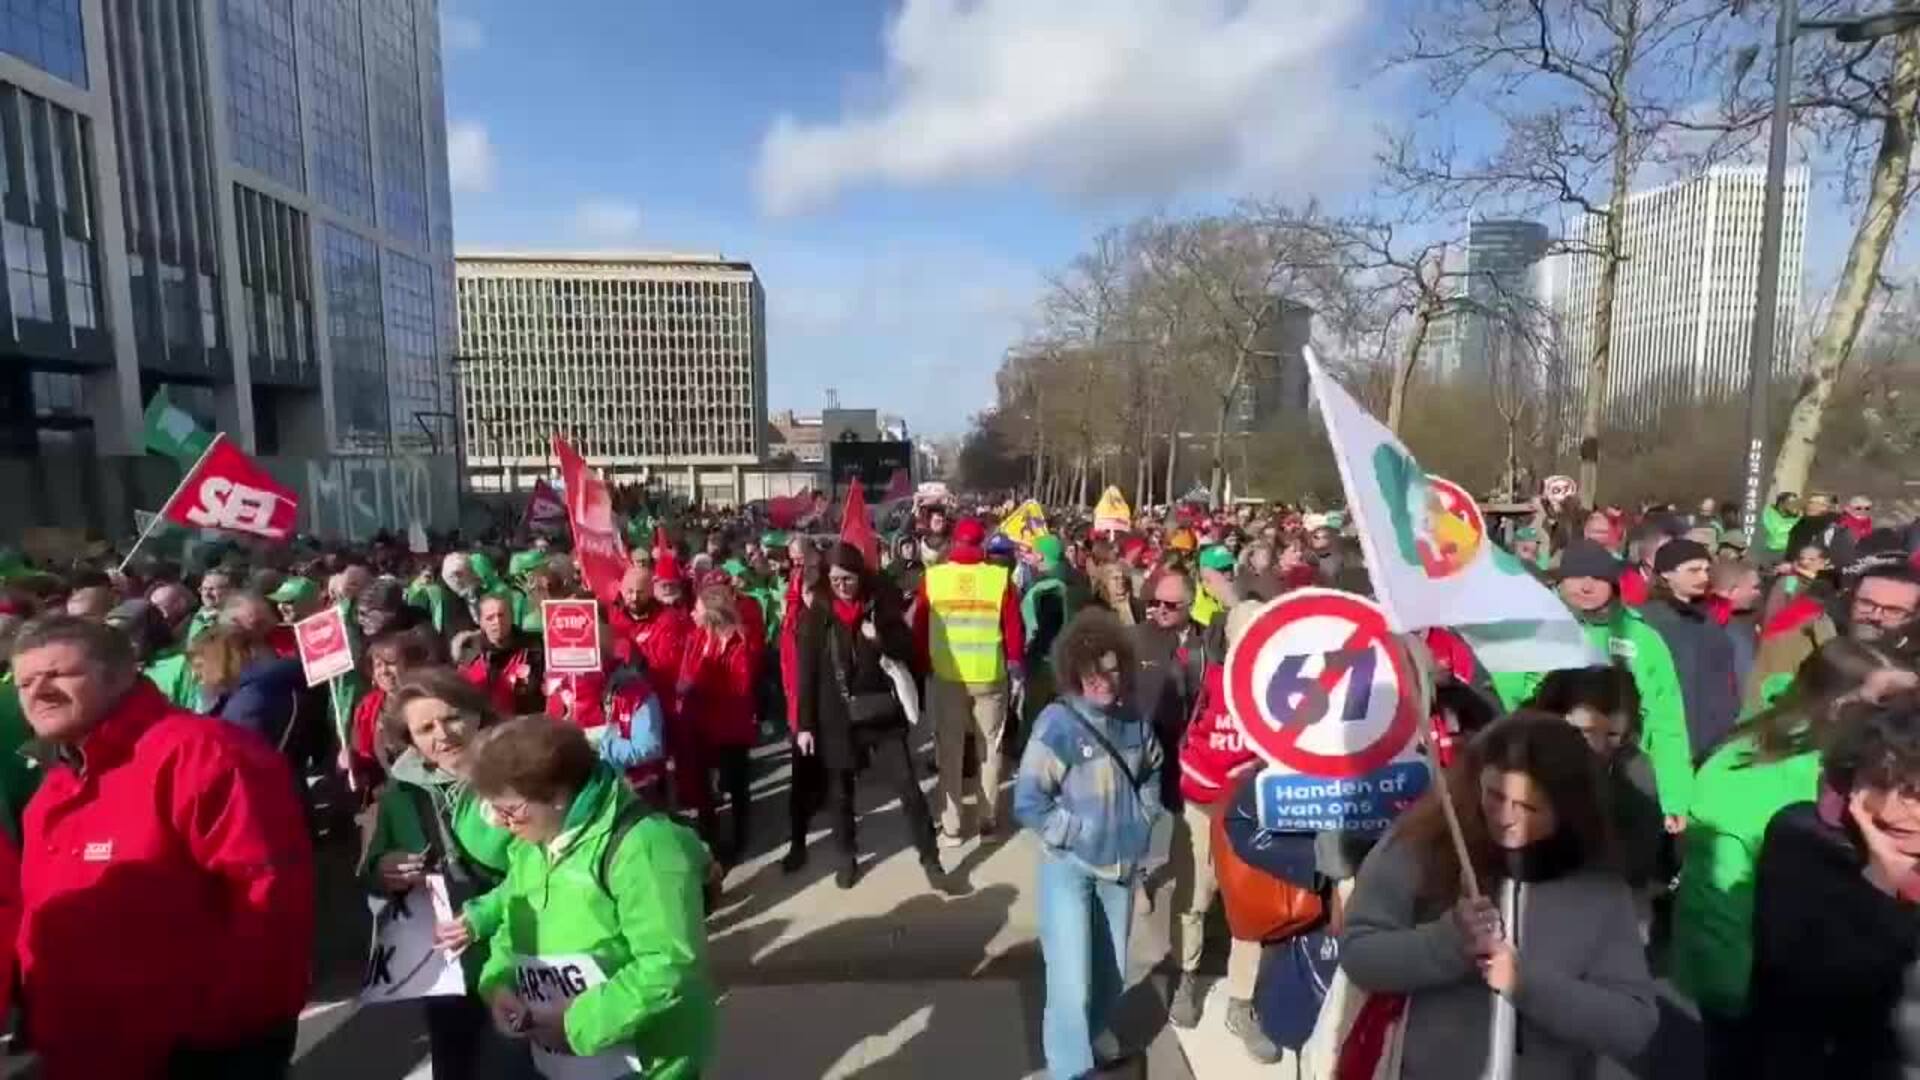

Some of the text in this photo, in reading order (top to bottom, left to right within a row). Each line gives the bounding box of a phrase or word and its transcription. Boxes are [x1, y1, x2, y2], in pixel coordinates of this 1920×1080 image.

[1275, 772, 1407, 801] Handen af
[1277, 802, 1372, 817] van ons
